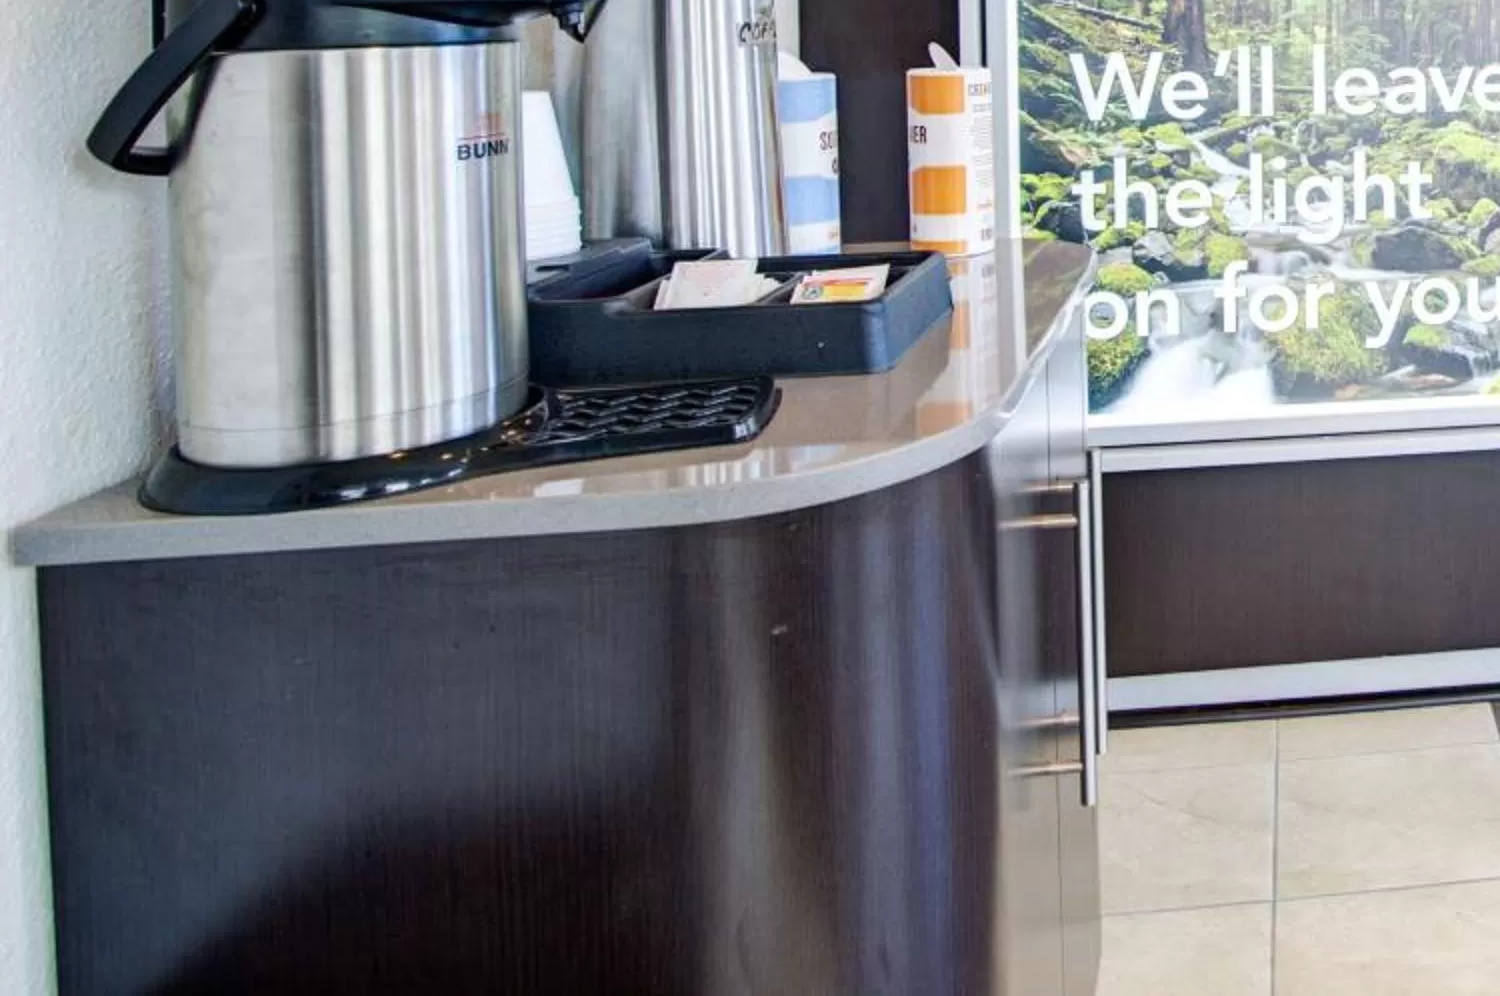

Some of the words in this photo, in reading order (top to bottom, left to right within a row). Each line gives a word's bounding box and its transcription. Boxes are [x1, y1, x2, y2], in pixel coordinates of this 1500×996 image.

[1069, 45, 1275, 121] We'll
[456, 139, 509, 161] BUNN
[1071, 156, 1214, 233] the
[1250, 147, 1433, 245] light
[1083, 287, 1184, 340] on
[1214, 260, 1335, 334] for
